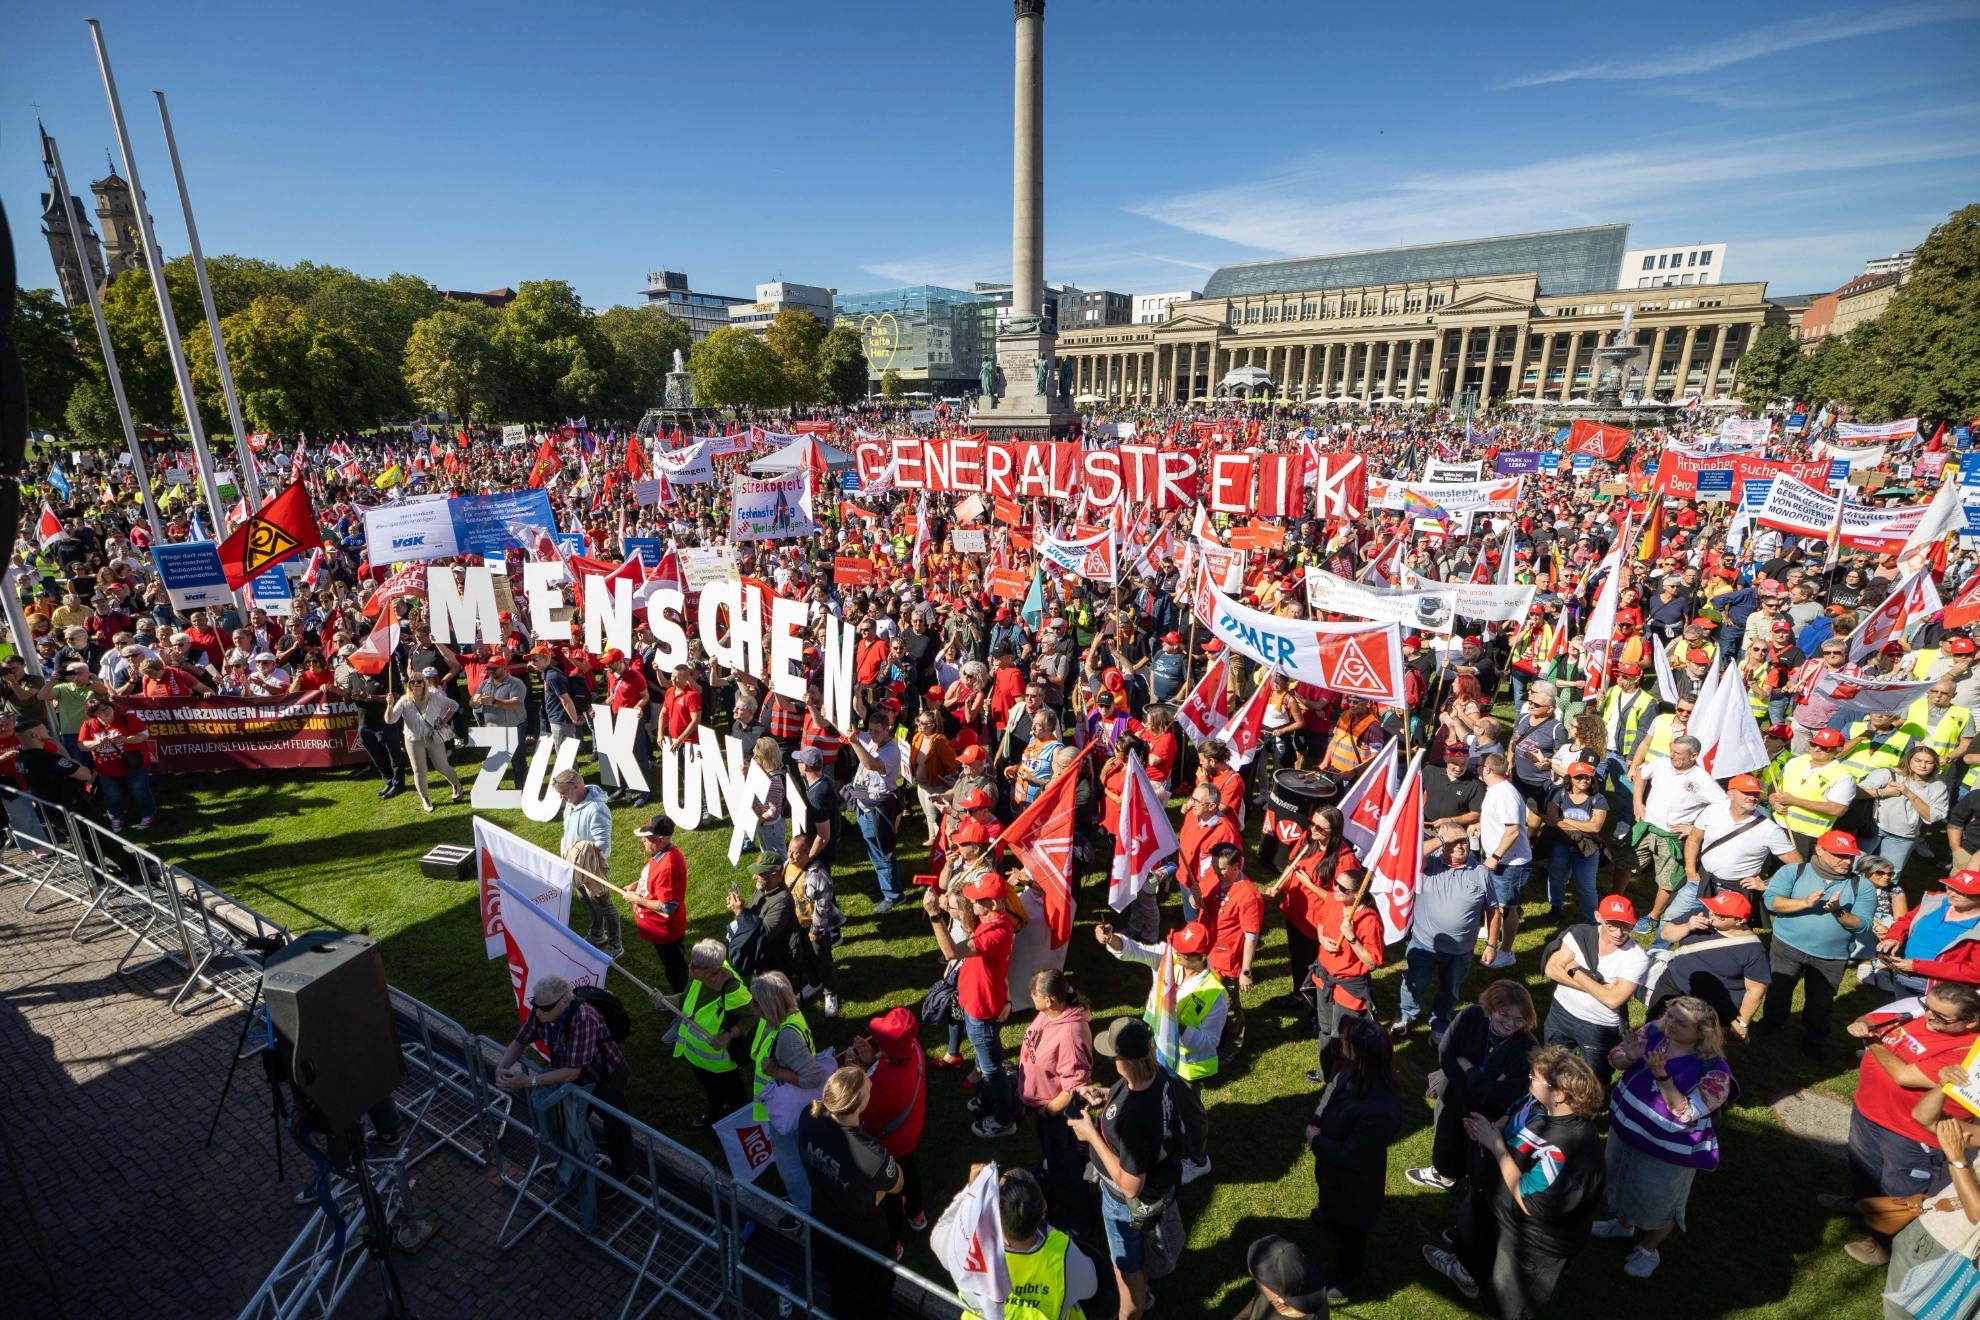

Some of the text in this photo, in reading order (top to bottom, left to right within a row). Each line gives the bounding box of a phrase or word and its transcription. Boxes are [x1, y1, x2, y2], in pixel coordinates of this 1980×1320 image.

[871, 326, 887, 335] Das
[869, 336, 890, 346] kalte
[870, 348, 889, 358] Herz
[857, 440, 1363, 518] GENERALSTREIK
[1791, 462, 1830, 480] Streit
[1420, 489, 1479, 498] rauensleute
[1768, 505, 1827, 527] MONOPOLEN
[1772, 496, 1792, 507] VON
[1793, 502, 1833, 521] REGIERUN
[1802, 497, 1893, 520] GENERAANGRIFF
[392, 536, 425, 548] VdK
[1456, 598, 1497, 606] rbeitsplätze
[428, 561, 856, 735] MENSCHEN
[173, 706, 256, 720] KÜRZUNGEN
[259, 706, 275, 718] IM
[278, 702, 358, 717] SOZIALSTAA
[148, 715, 359, 736] SERE RECHTE, UNSERE ZUKUNFT
[160, 738, 343, 756] VERTRAUENSLEUTE BOSCH FEUERBACH
[1959, 1088, 1973, 1100] Mit
[806, 1142, 841, 1175] MKS
[1015, 1283, 1050, 1296] gibt's
[1004, 1297, 1041, 1308] KTIV
